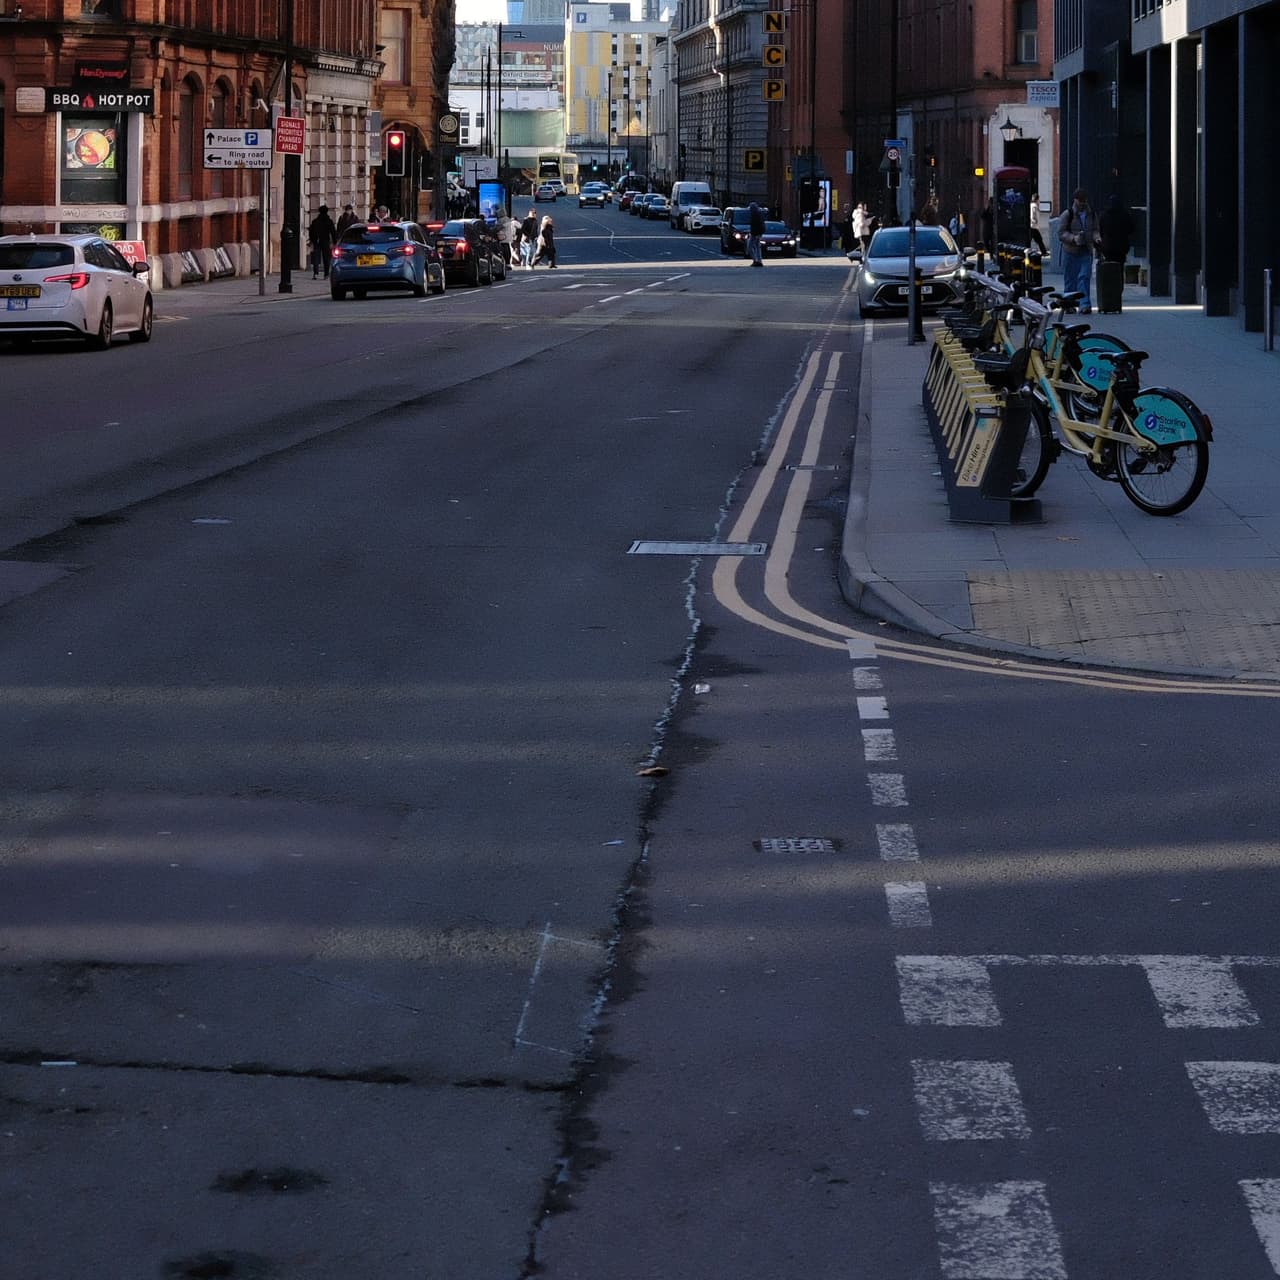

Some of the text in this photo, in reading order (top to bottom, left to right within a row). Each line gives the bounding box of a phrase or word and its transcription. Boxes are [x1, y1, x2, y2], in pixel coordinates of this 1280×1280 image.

[53, 94, 80, 106] BBQ
[98, 94, 124, 106] HOT
[126, 95, 151, 106] POT
[280, 121, 301, 129] SIGNALS
[217, 135, 242, 143] Palace
[278, 136, 302, 144] CHANGED
[281, 143, 298, 151] AHEAD
[229, 151, 246, 159] Ring
